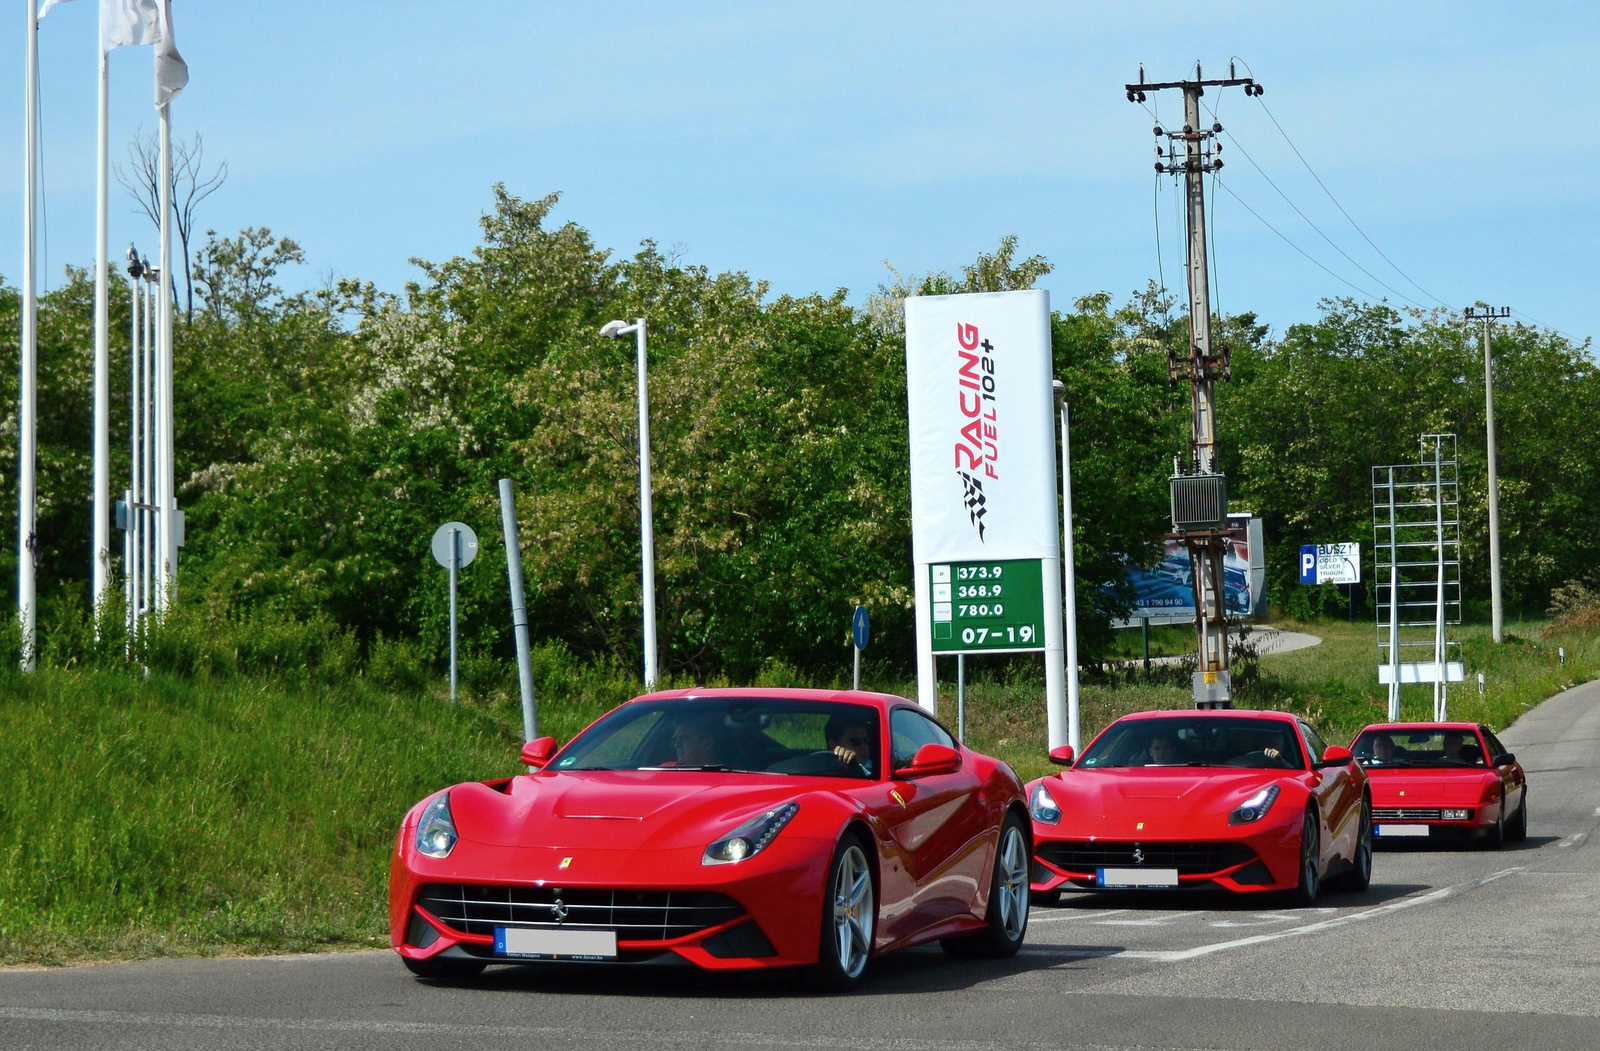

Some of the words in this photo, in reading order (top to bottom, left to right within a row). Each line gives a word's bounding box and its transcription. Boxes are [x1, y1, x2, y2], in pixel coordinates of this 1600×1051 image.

[981, 338, 996, 401] 102+
[955, 322, 983, 471] RACING
[983, 407, 999, 480] FUEL
[1319, 545, 1347, 555] BUSZ
[959, 566, 1002, 579] 373.9
[958, 584, 1002, 598] 368.9
[958, 603, 1004, 617] 780.0
[962, 625, 1033, 644] 07-19
